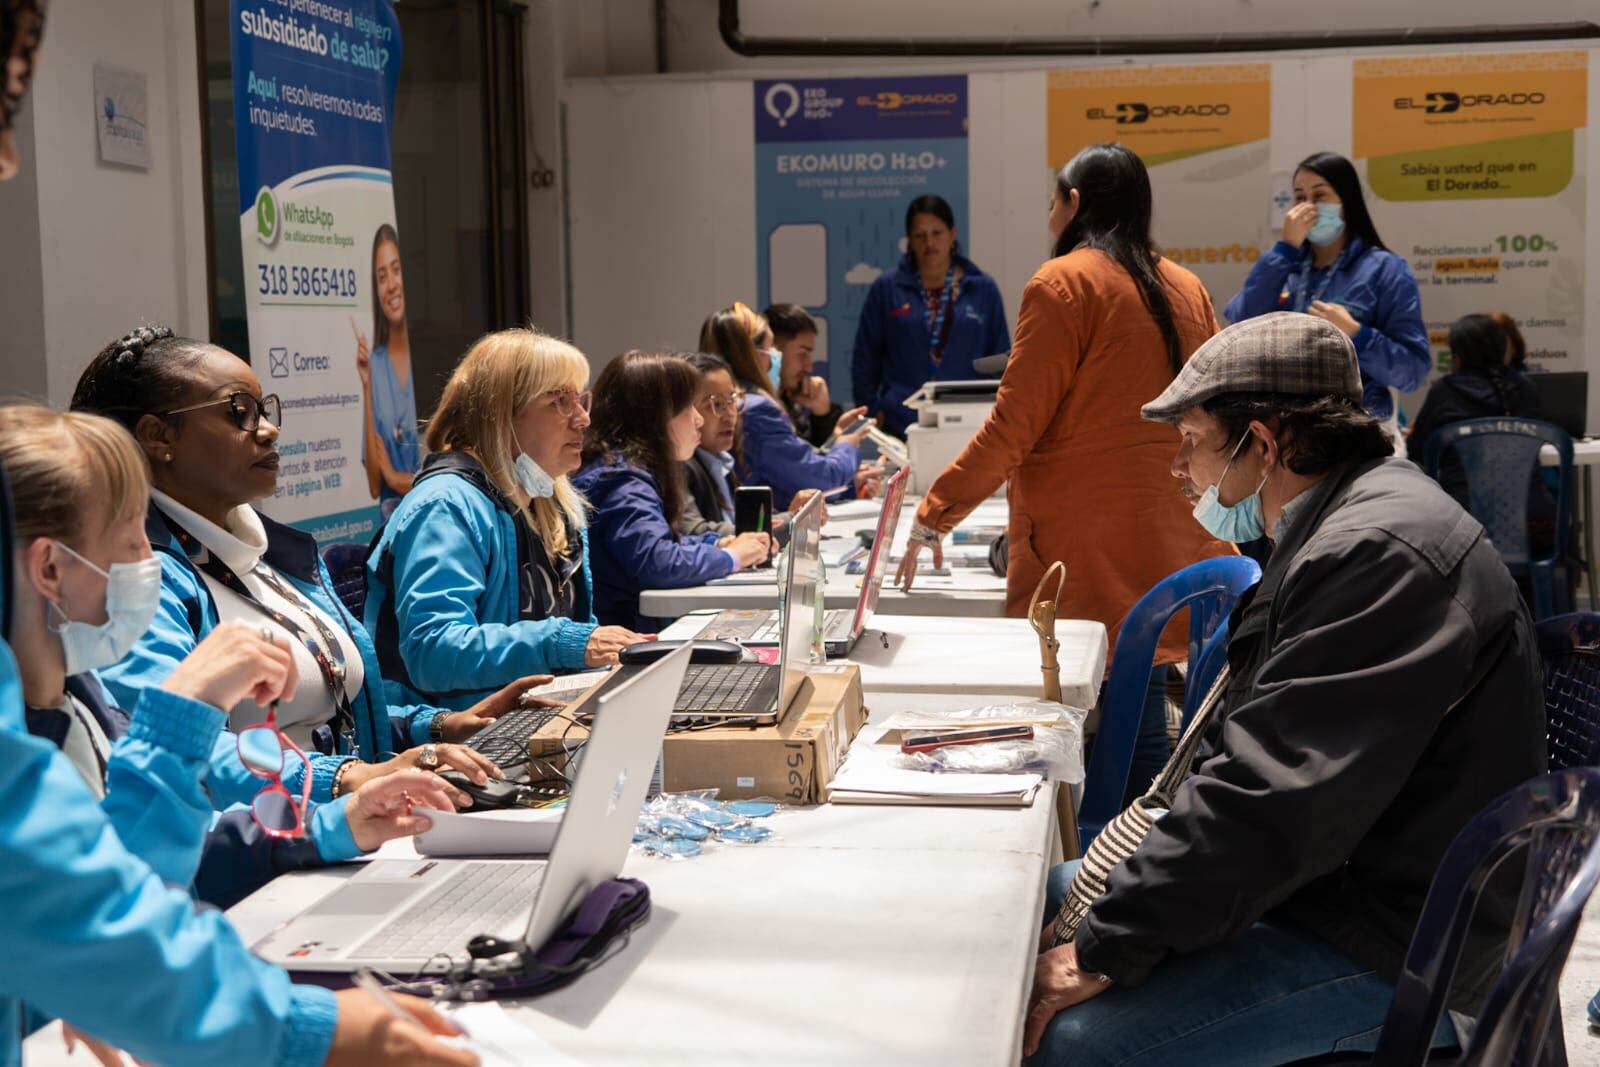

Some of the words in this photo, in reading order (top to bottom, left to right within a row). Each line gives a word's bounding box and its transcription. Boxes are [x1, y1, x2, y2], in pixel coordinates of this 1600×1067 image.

[240, 9, 328, 56] subsidiado
[330, 31, 348, 62] de
[281, 84, 352, 116] resolveremos
[352, 101, 384, 124] todas
[803, 98, 845, 108] GROUP
[1424, 92, 1545, 113] DORADO
[249, 102, 317, 136] inquietudes.
[1115, 103, 1231, 124] DORADO
[776, 153, 886, 173] EKOMURO
[1444, 162, 1483, 174] usted
[1487, 163, 1515, 176] que
[1518, 162, 1537, 172] en
[1426, 179, 1441, 192] El
[283, 202, 334, 231] WhatsApp
[1413, 245, 1477, 256] Reciclamos
[1495, 234, 1558, 252] 100%
[1502, 259, 1524, 272] que
[1527, 259, 1549, 269] cae
[258, 264, 288, 295] 318
[292, 267, 357, 297] 5865418
[1432, 274, 1444, 285] la
[1446, 273, 1498, 285] terminal.
[1526, 316, 1567, 328] damos
[1525, 348, 1568, 360] siduos
[307, 438, 341, 453] nuestros
[279, 463, 300, 477] untos
[784, 742, 805, 800] 1569
